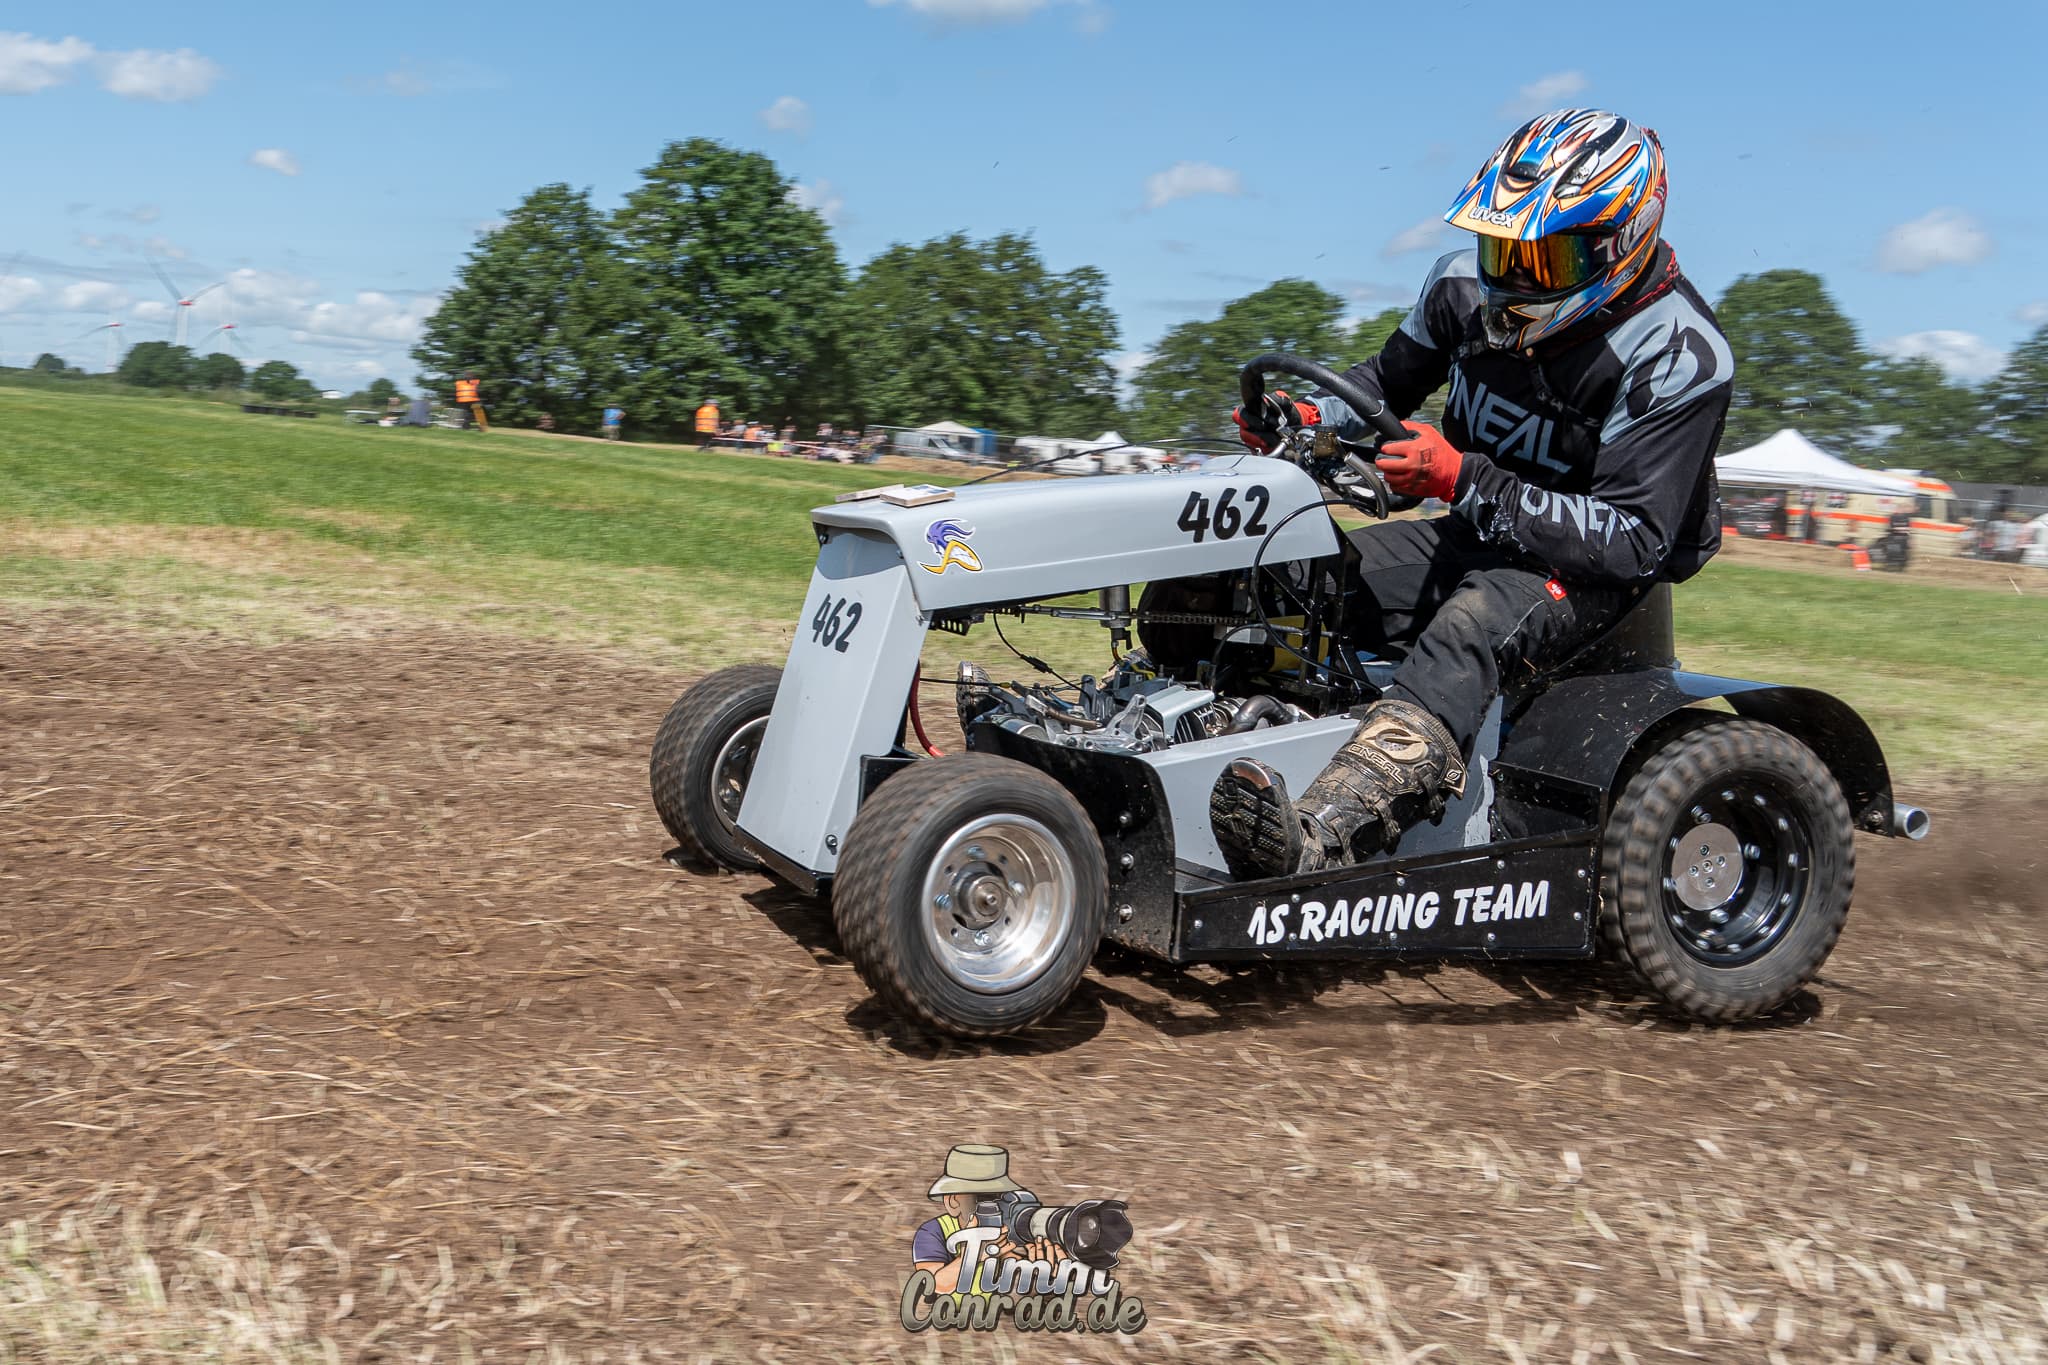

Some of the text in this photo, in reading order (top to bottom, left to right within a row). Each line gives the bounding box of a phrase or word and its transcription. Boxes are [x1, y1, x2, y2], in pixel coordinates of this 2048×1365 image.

[1468, 206, 1518, 229] uvex
[1177, 484, 1270, 543] 462
[812, 593, 863, 654] 462
[1299, 891, 1440, 942] RACING
[1453, 880, 1549, 926] TEAM
